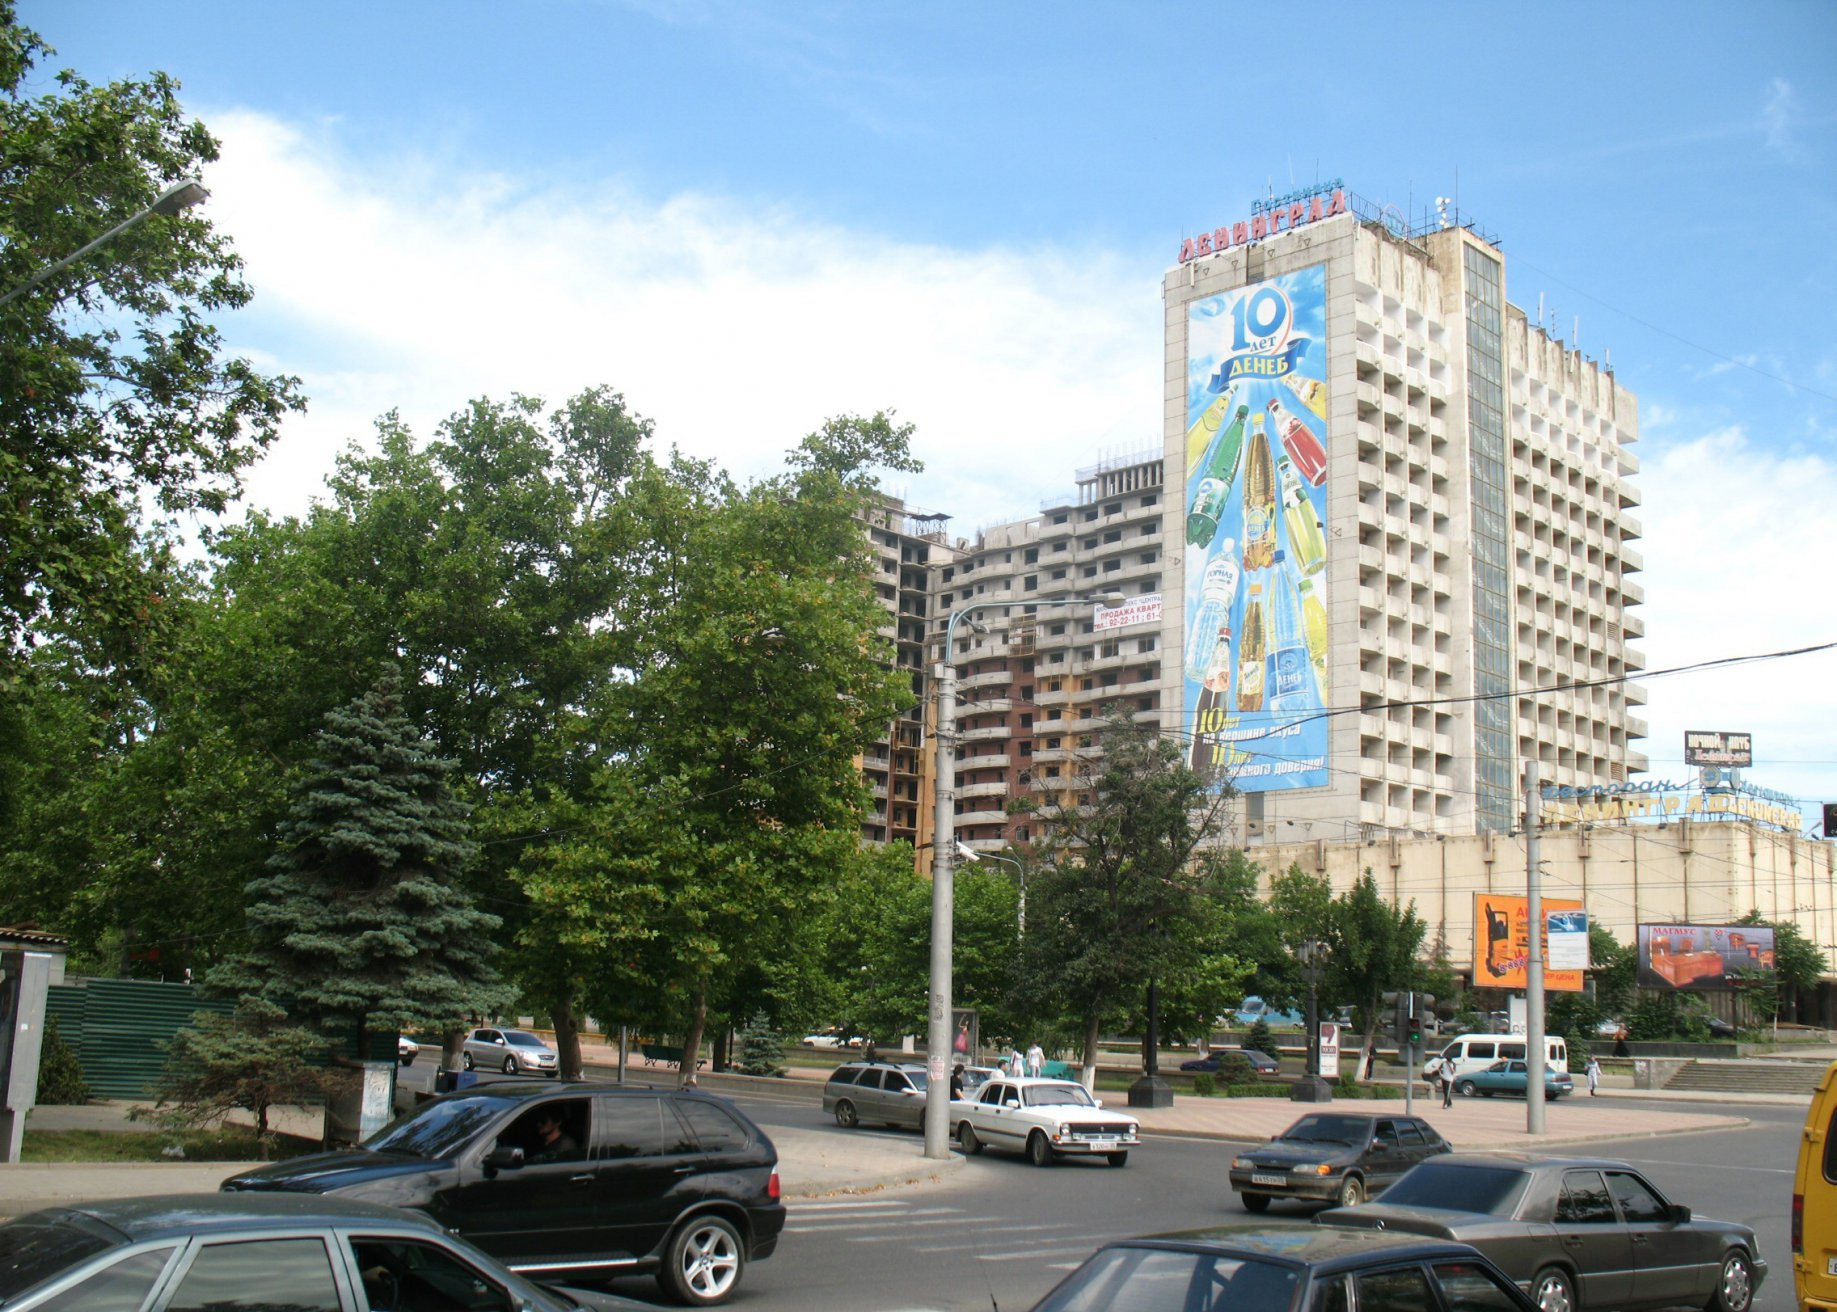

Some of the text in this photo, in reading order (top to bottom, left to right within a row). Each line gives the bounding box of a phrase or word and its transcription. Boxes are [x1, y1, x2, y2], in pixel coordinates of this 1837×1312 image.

[1178, 189, 1346, 264] ЛЕНИНГРАД
[1230, 287, 1287, 351] 10
[1250, 336, 1276, 352] лет
[1230, 356, 1289, 377] ДЕНЕБ
[1101, 607, 1135, 620] ПРОДАЖА
[1136, 603, 1162, 613] КВАРТ
[1110, 614, 1140, 627] 92-22-11
[1198, 708, 1241, 734] 10 лет
[1219, 727, 1266, 742] вершине
[1269, 723, 1301, 739] вкуса
[1275, 756, 1325, 776] доверия!
[1653, 927, 1697, 935] МАГМУС
